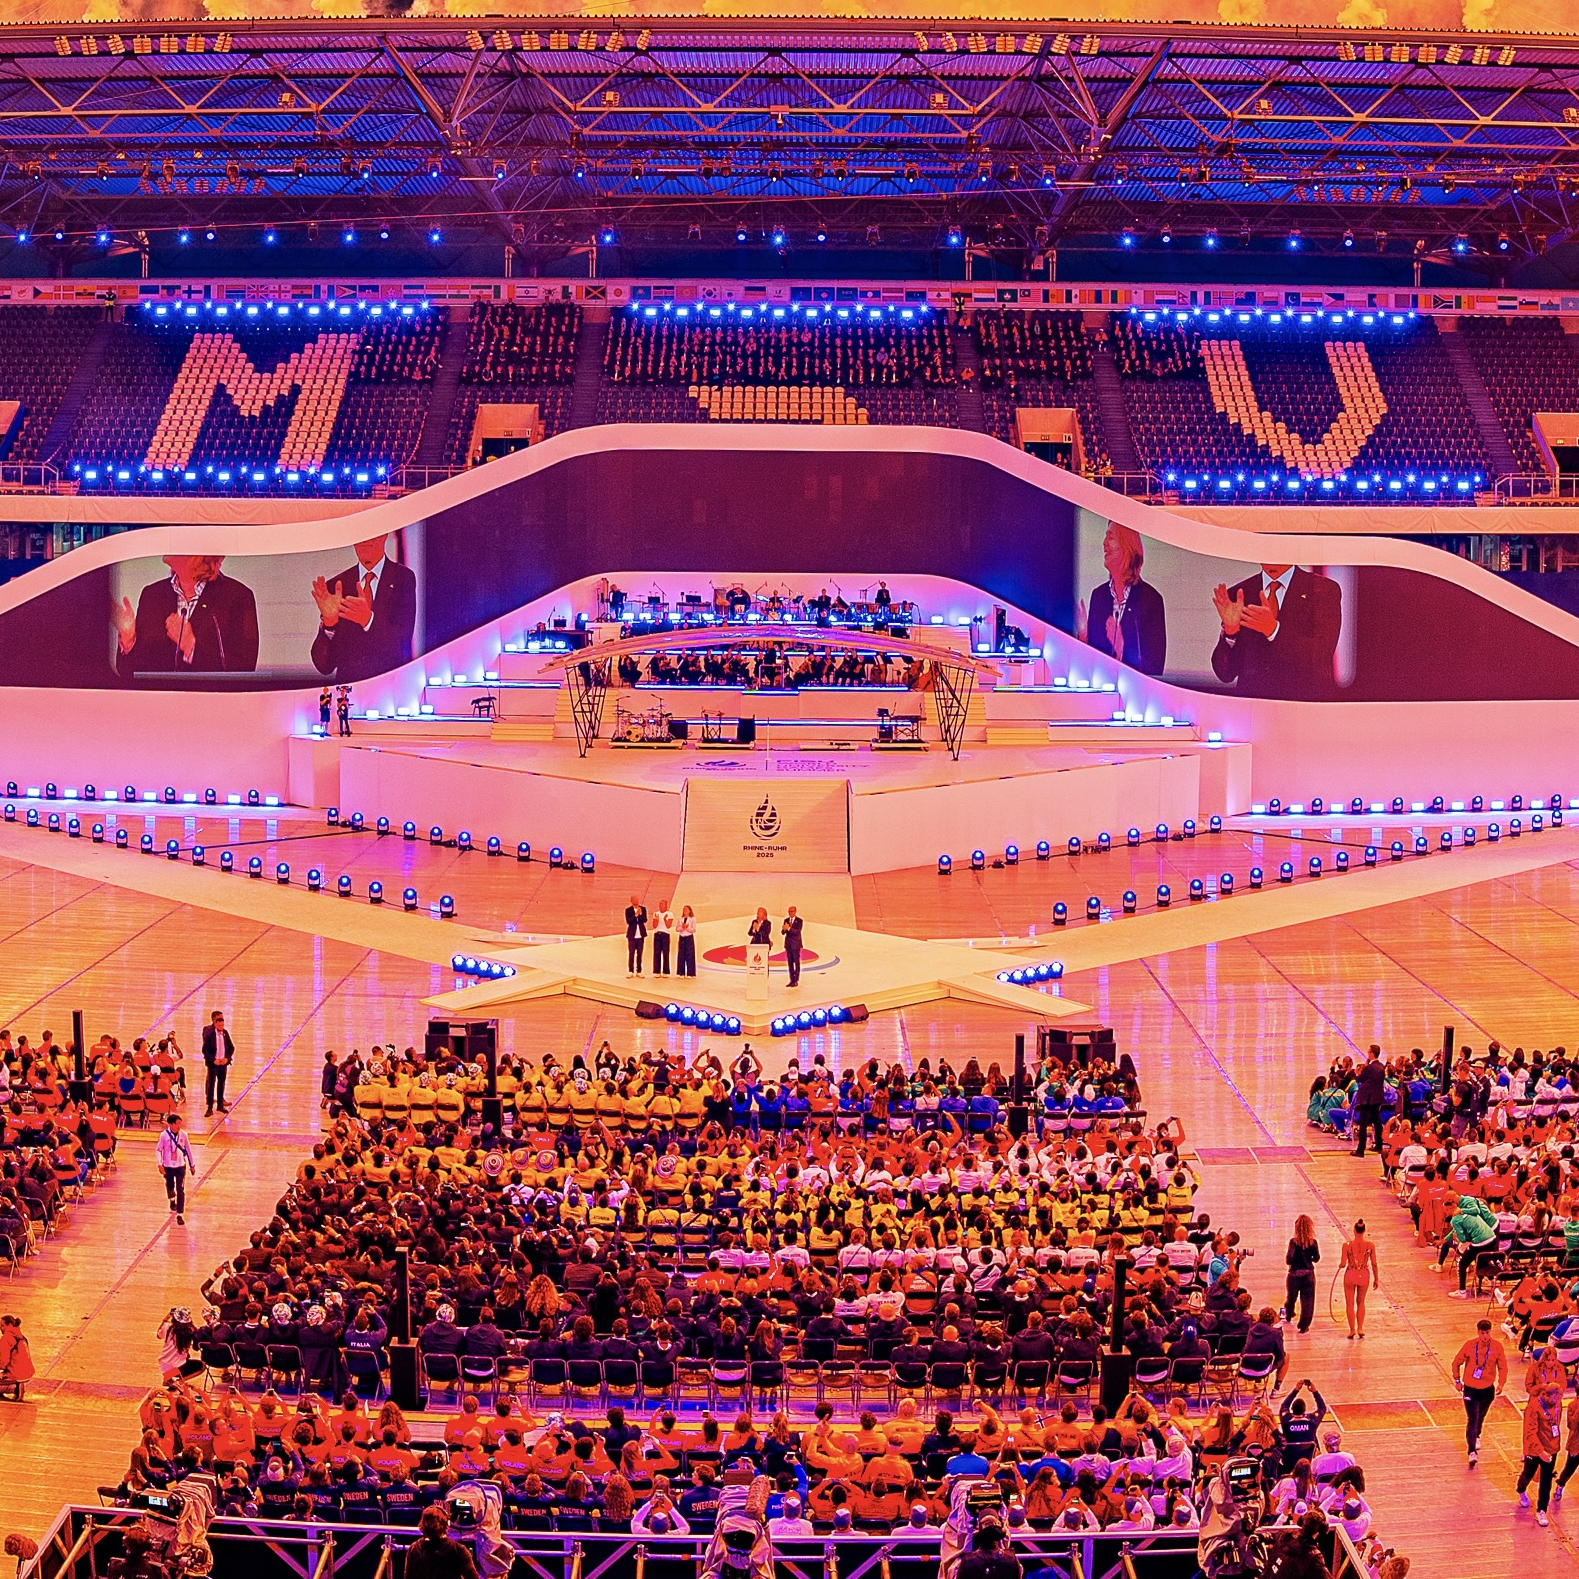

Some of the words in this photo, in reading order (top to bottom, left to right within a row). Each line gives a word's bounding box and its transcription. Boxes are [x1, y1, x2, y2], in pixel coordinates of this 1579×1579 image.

[343, 1491, 369, 1501] SWEDEN
[386, 1493, 413, 1502] SWEDEN
[691, 1501, 719, 1511] SWEDEN
